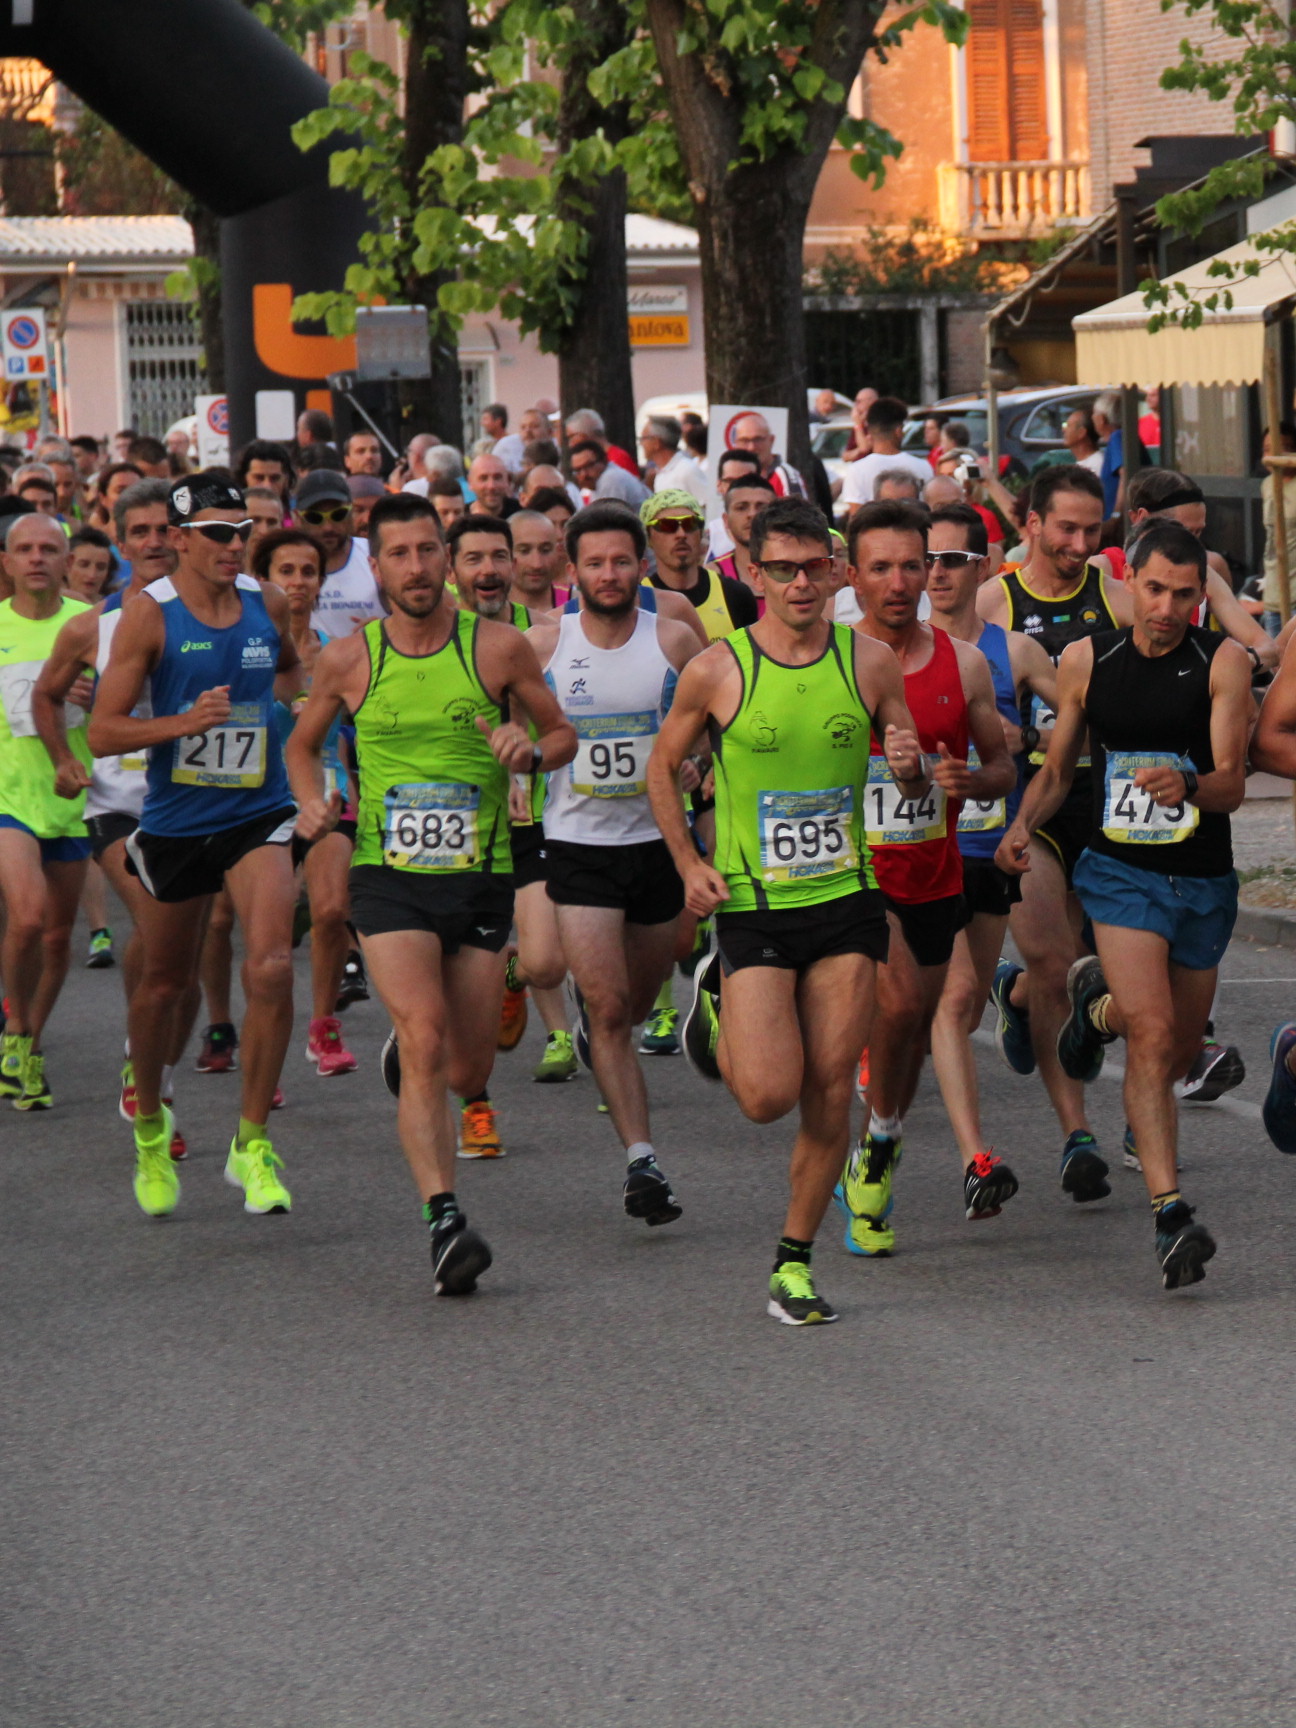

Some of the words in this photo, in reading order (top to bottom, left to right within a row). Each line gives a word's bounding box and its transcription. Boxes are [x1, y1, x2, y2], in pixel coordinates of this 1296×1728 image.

[184, 731, 255, 769] 217
[590, 742, 636, 779] 95
[872, 784, 936, 825] 144
[398, 813, 465, 849] 683
[773, 818, 843, 861] 695
[882, 831, 914, 842] HOKA
[1127, 830, 1158, 840] HOKA
[788, 864, 820, 878] HOKA
